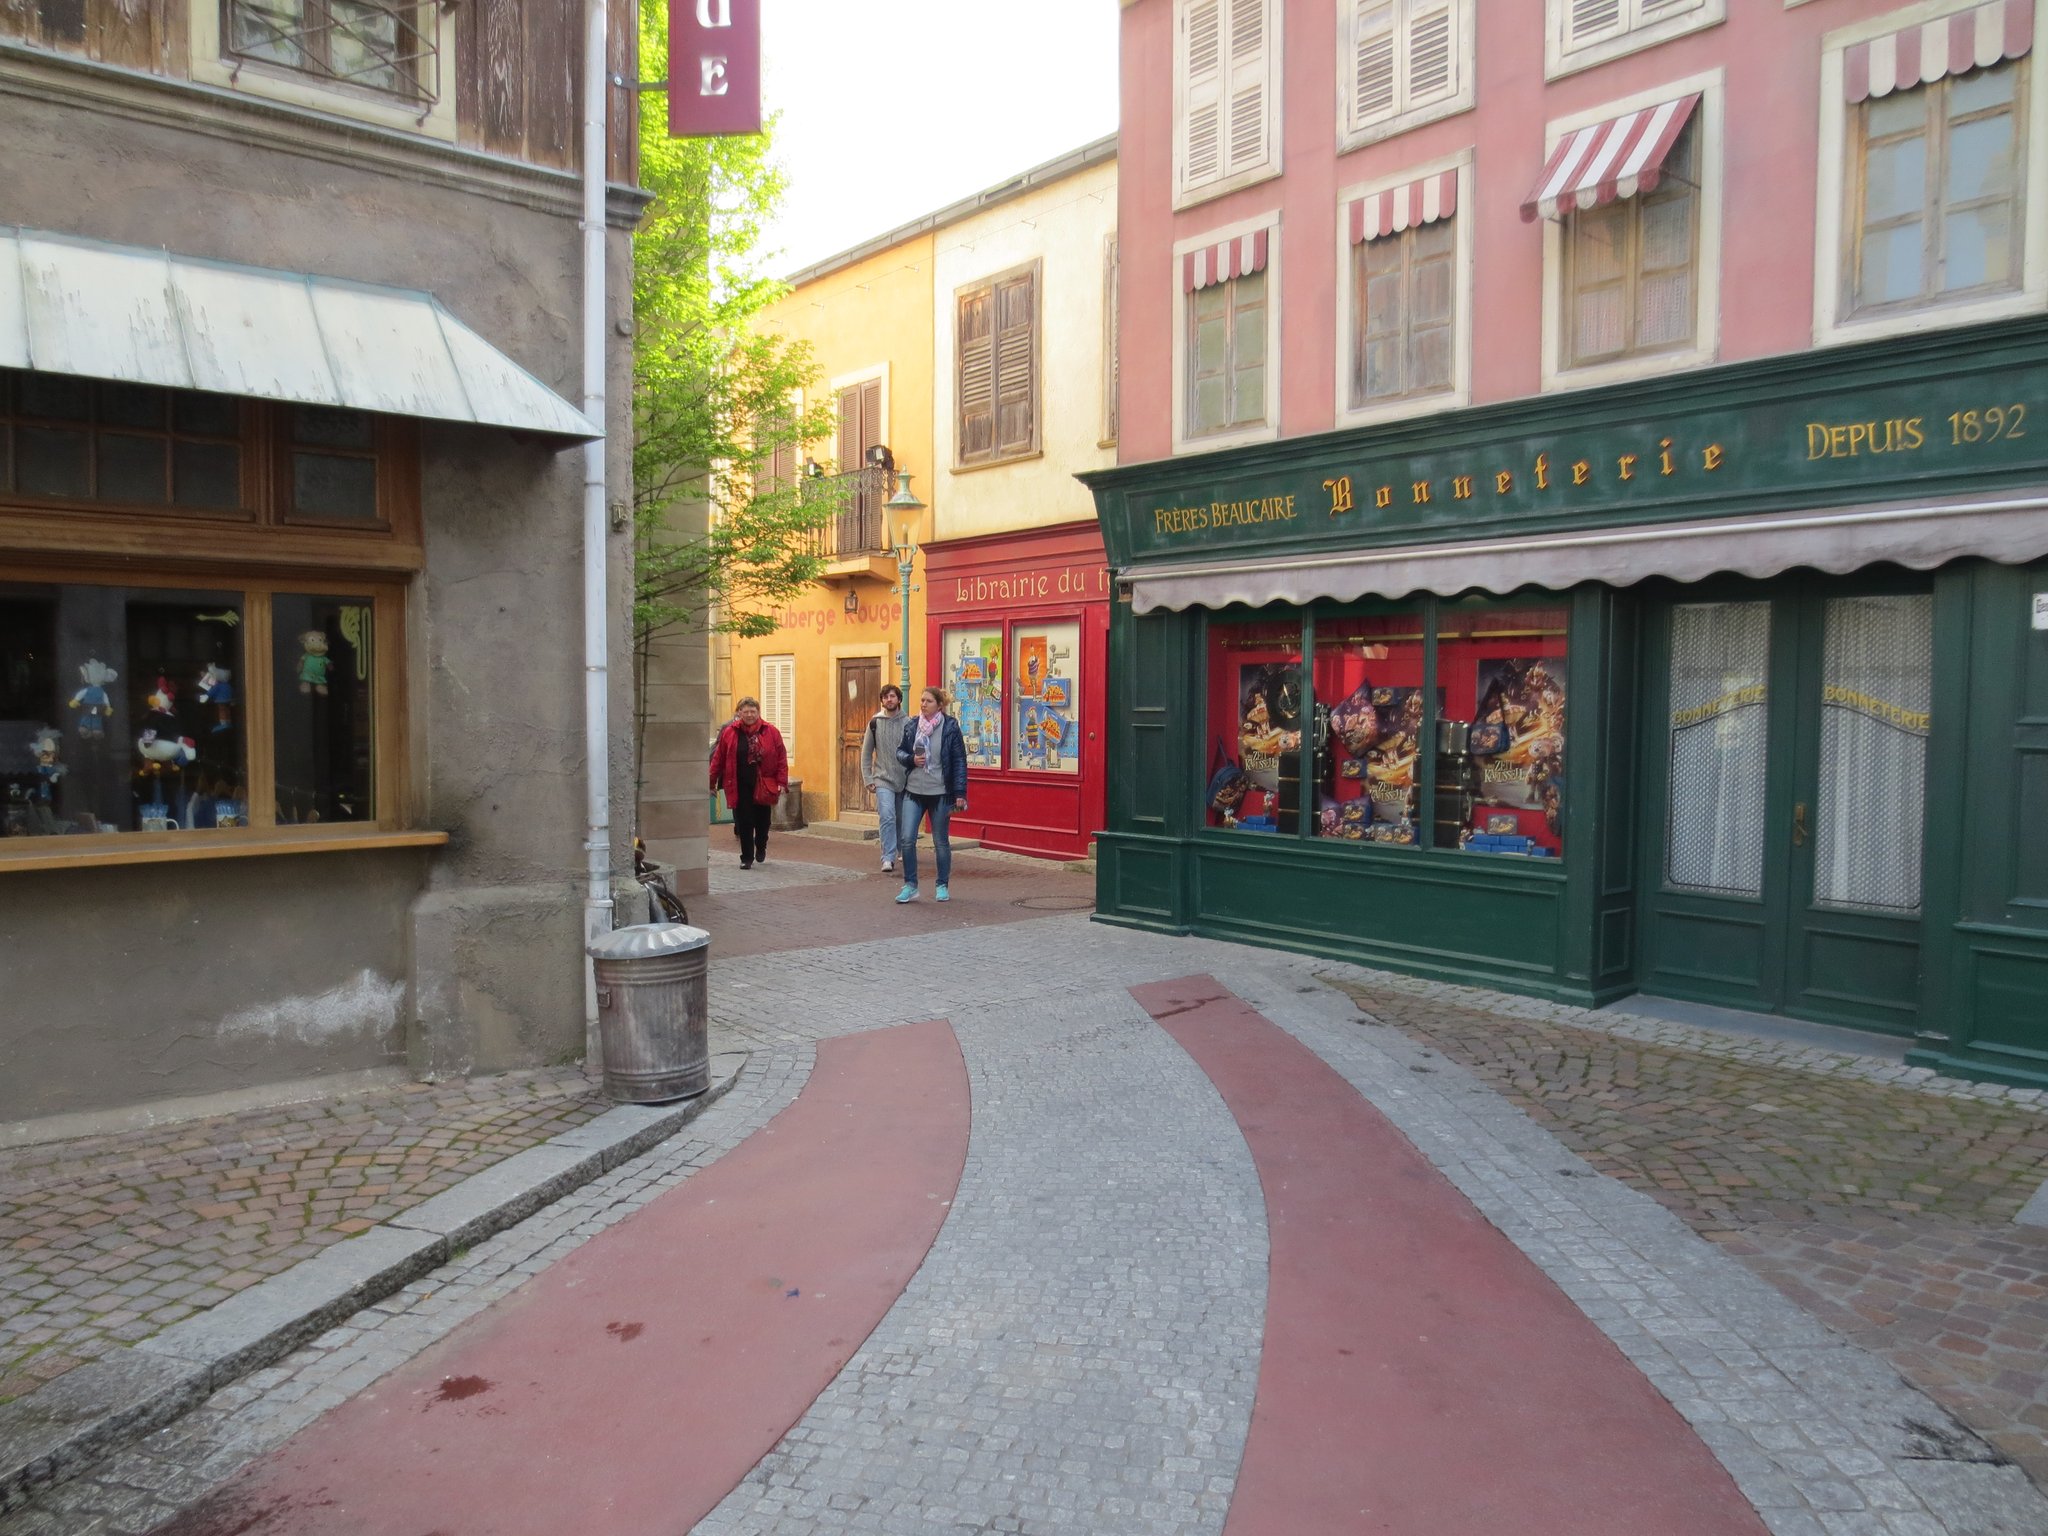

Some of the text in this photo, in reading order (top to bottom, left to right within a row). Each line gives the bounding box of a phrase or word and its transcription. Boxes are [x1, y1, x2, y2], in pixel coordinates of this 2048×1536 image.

[1806, 403, 2027, 460] DEPUIS 1892
[1322, 438, 1724, 519] Bonneterie
[1154, 495, 1298, 534] FRÈRES BEAUCAIRE
[956, 567, 1110, 602] Librairie du t
[1823, 685, 1930, 730] BONNETERIE
